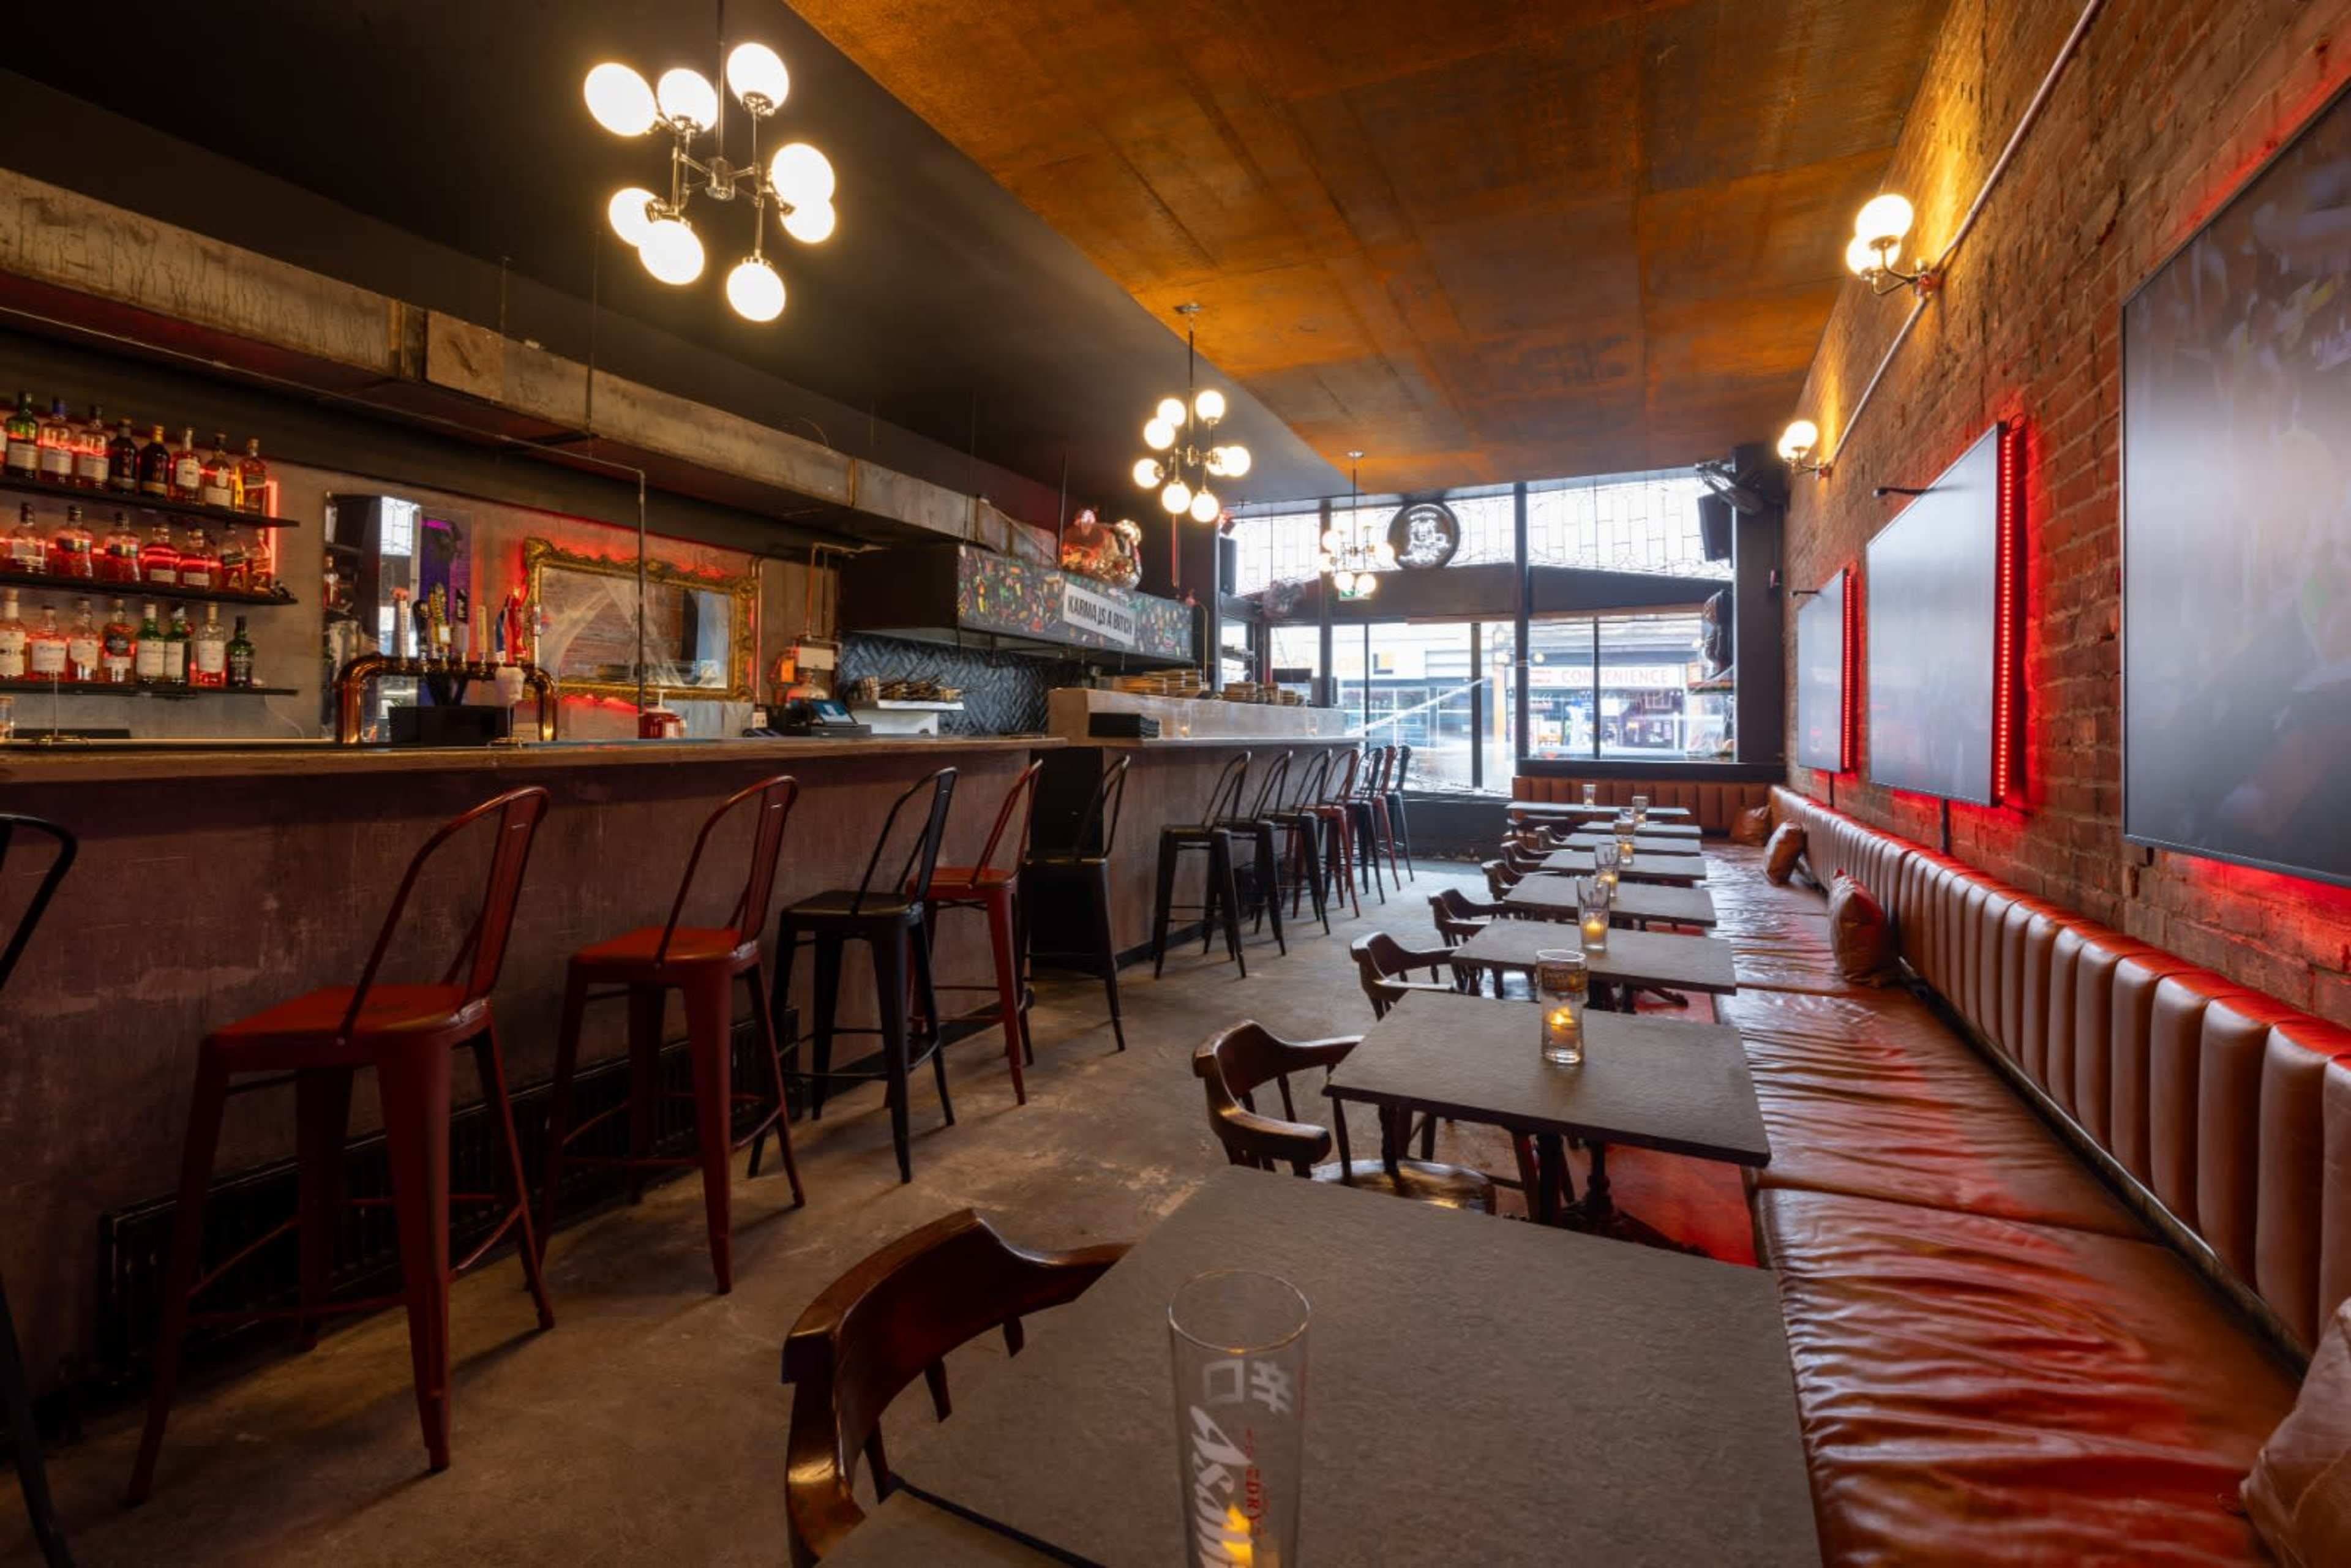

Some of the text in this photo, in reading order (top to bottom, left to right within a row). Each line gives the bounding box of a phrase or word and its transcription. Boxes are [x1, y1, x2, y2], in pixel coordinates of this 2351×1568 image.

[1068, 595, 1132, 636] KARMA IS A BITCH
